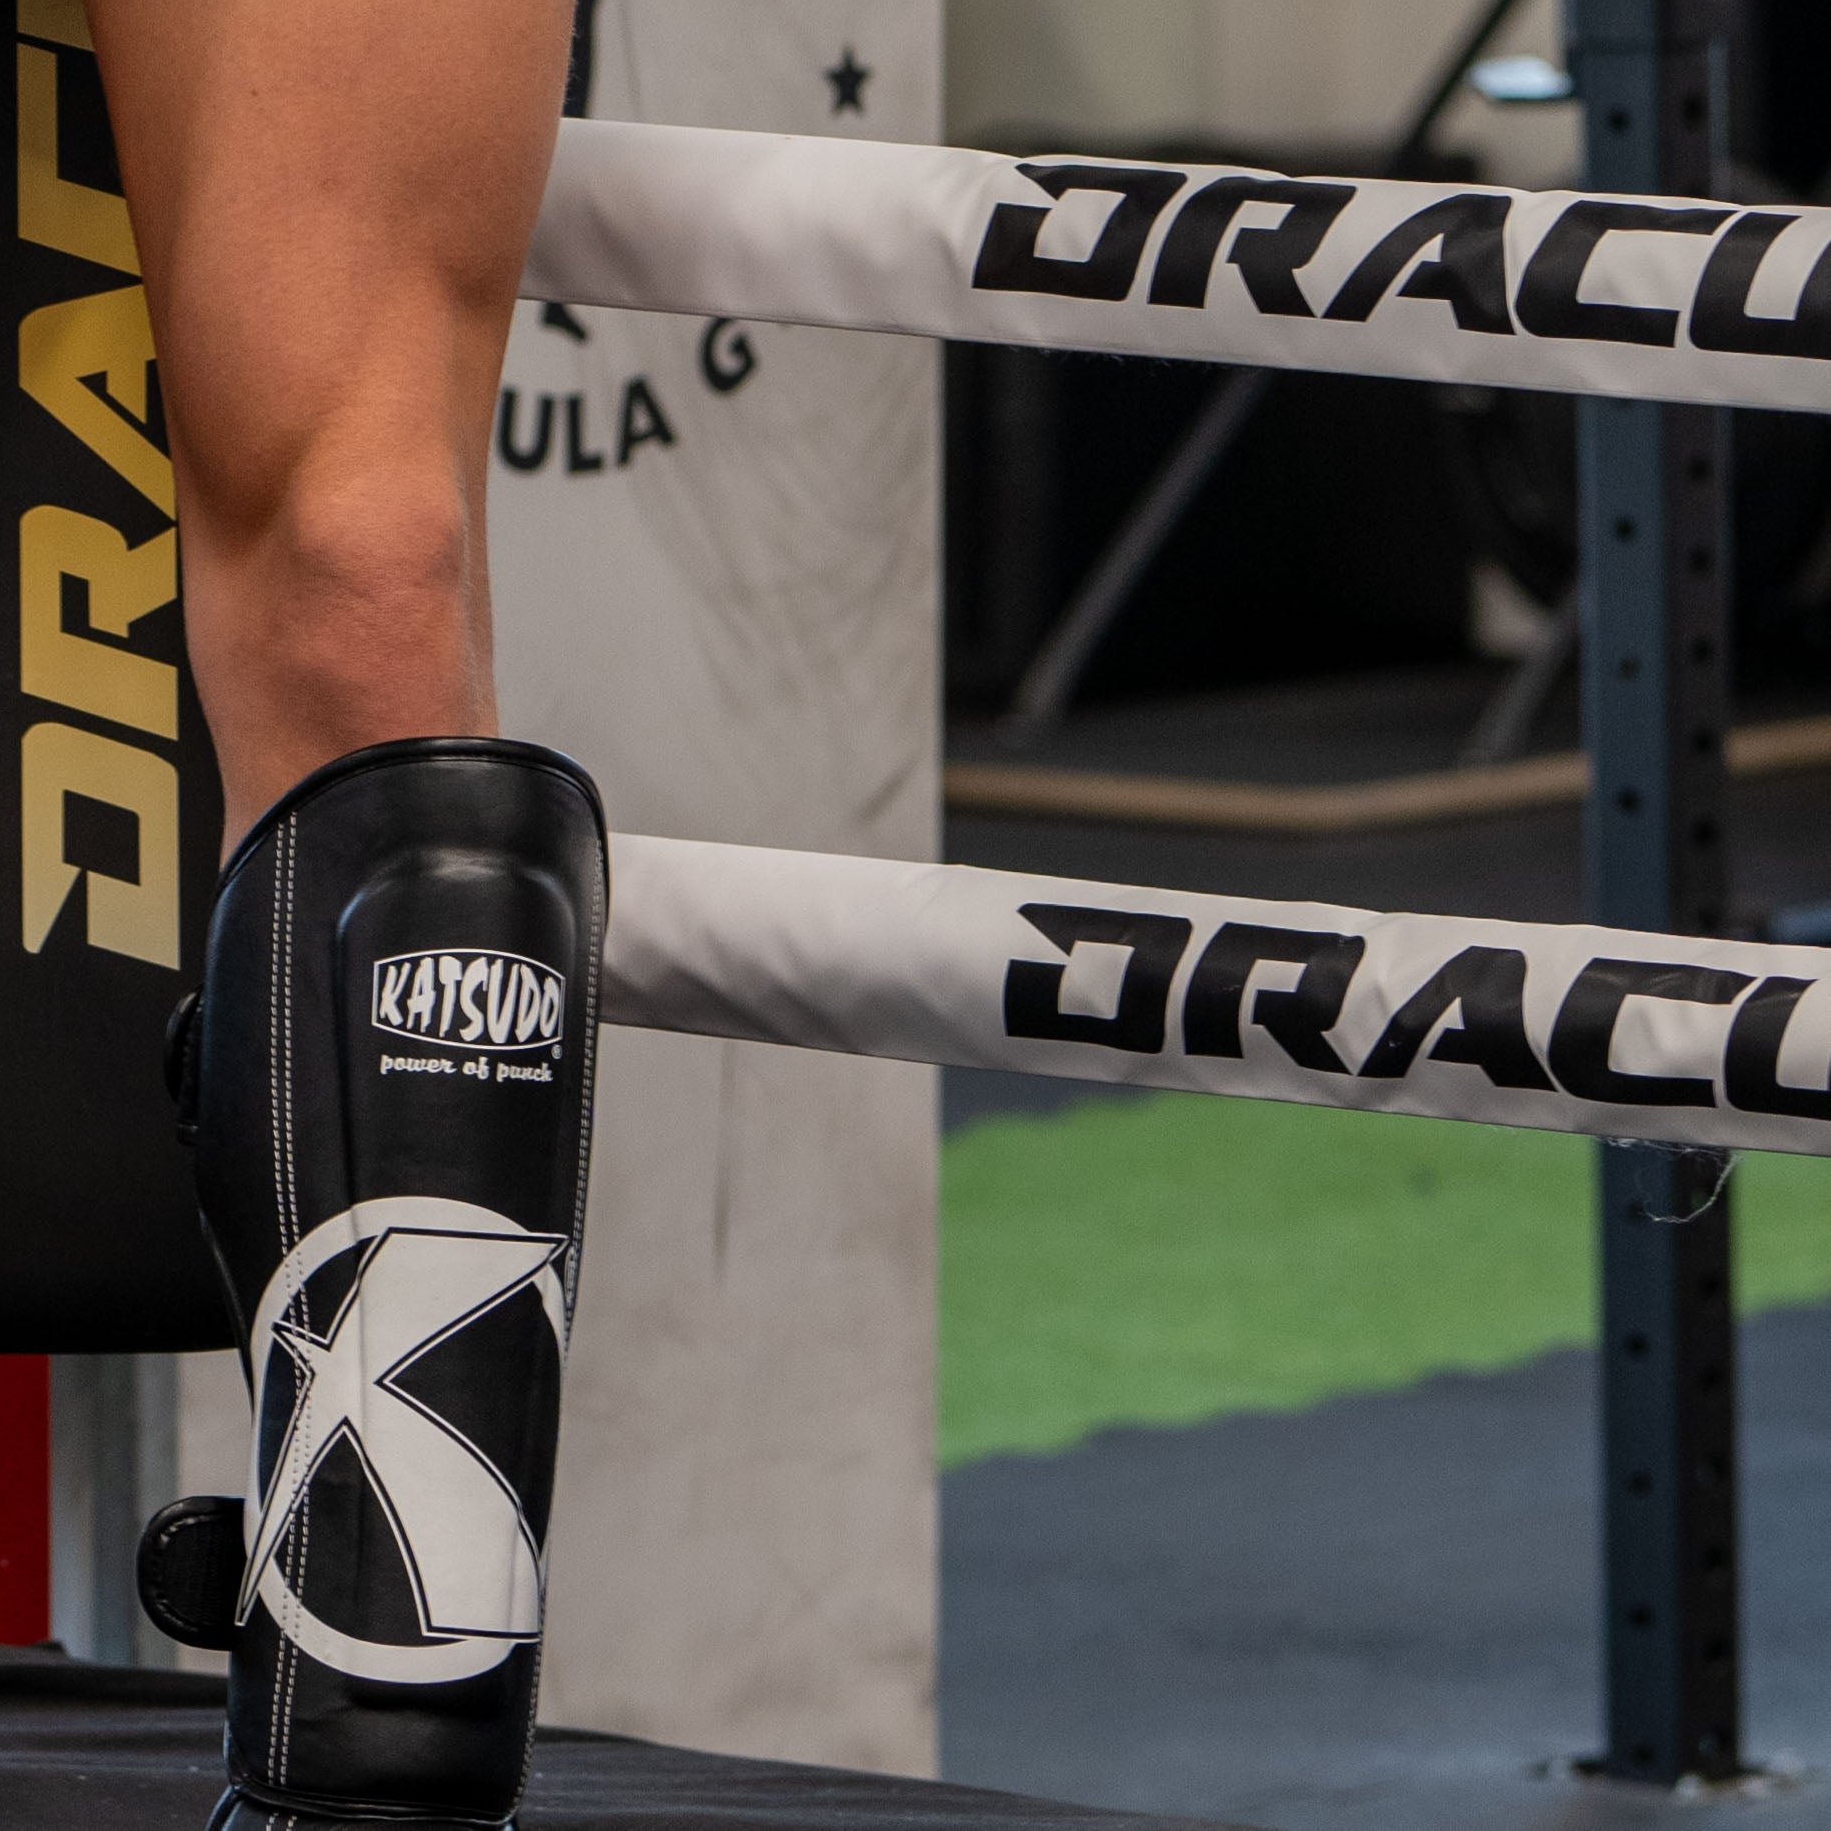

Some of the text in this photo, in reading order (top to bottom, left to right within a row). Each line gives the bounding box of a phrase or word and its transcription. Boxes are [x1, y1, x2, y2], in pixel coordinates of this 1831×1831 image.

[971, 162, 1831, 360] DRACU
[379, 955, 560, 1044] KATSUDO
[380, 1053, 554, 1082] power of punch
